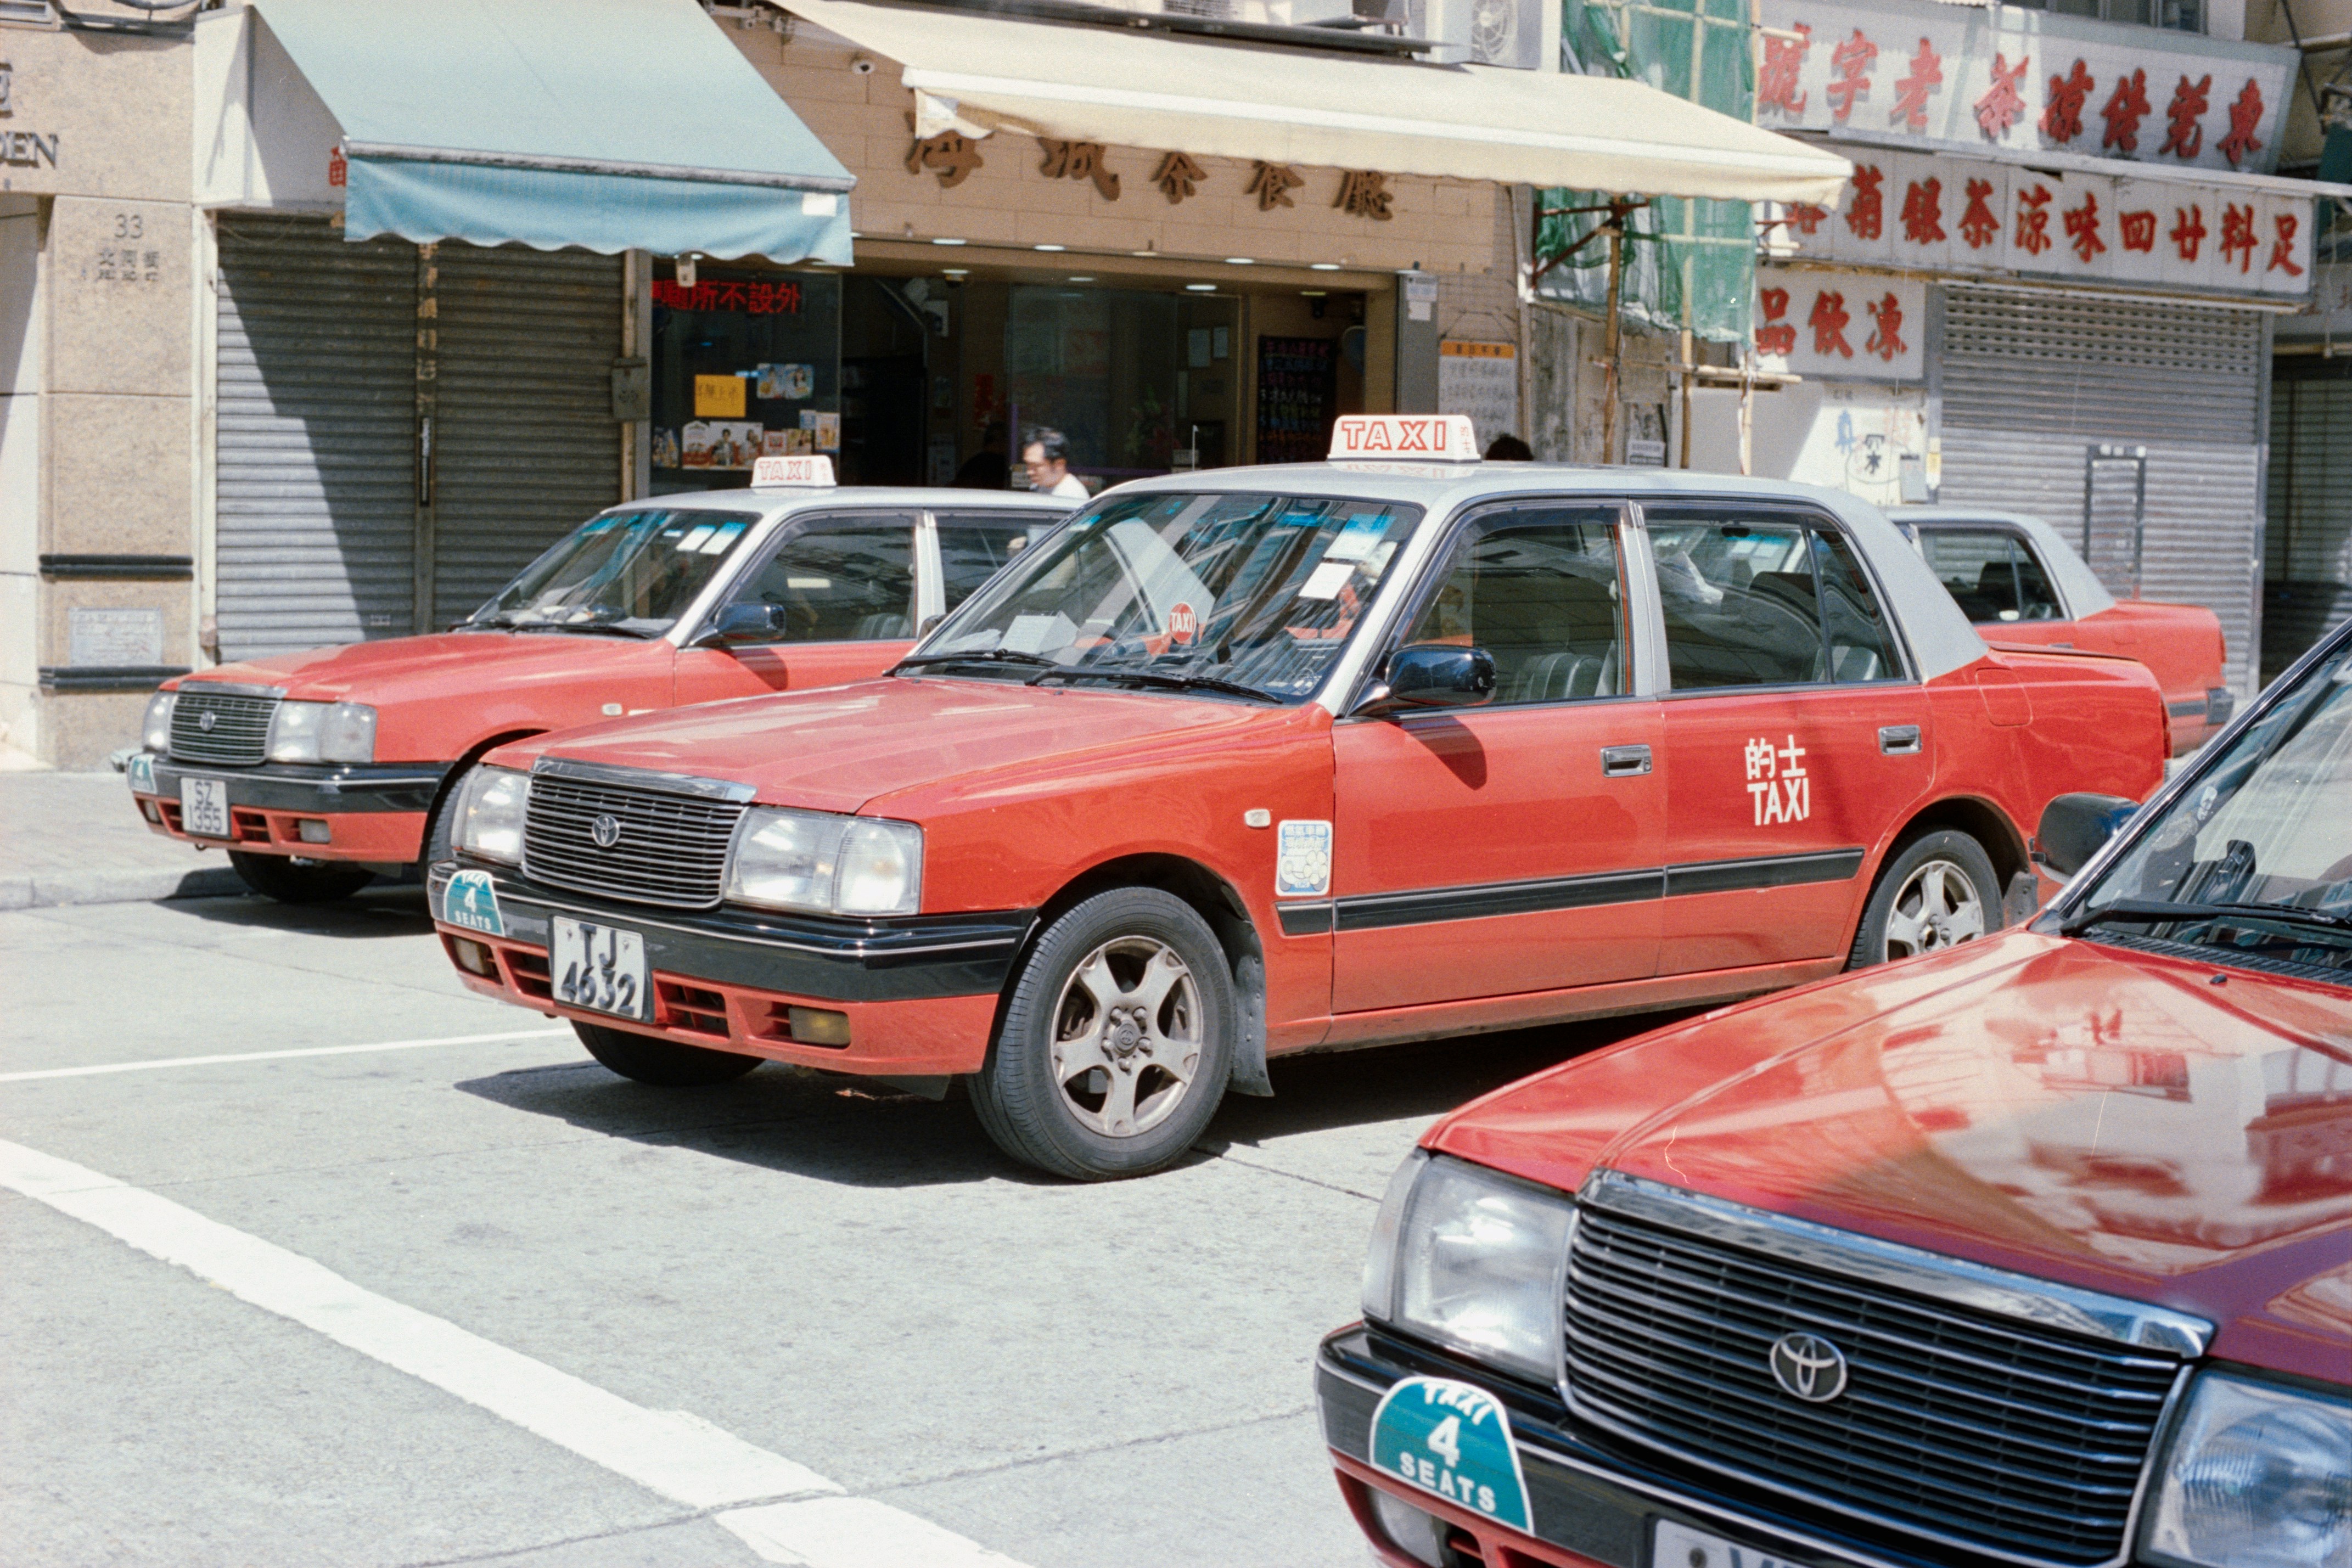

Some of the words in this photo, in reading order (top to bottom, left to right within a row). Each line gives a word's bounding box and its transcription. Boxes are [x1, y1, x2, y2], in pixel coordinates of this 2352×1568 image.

[0, 131, 59, 169] EN
[114, 213, 143, 239] 33
[1341, 420, 1446, 451] TAXI
[758, 460, 812, 481] TAXI
[1171, 612, 1193, 632] TAXI
[1745, 734, 1806, 780] 的士
[195, 781, 213, 806] SZ
[1747, 778, 1809, 825] TAXI
[464, 886, 476, 913] 4
[454, 911, 492, 930] SEATS
[579, 923, 616, 968] TJ
[561, 962, 636, 1014] 4632
[1424, 1382, 1493, 1425] TAXI
[1428, 1415, 1460, 1468] 4
[1400, 1452, 1496, 1513] SEATS
